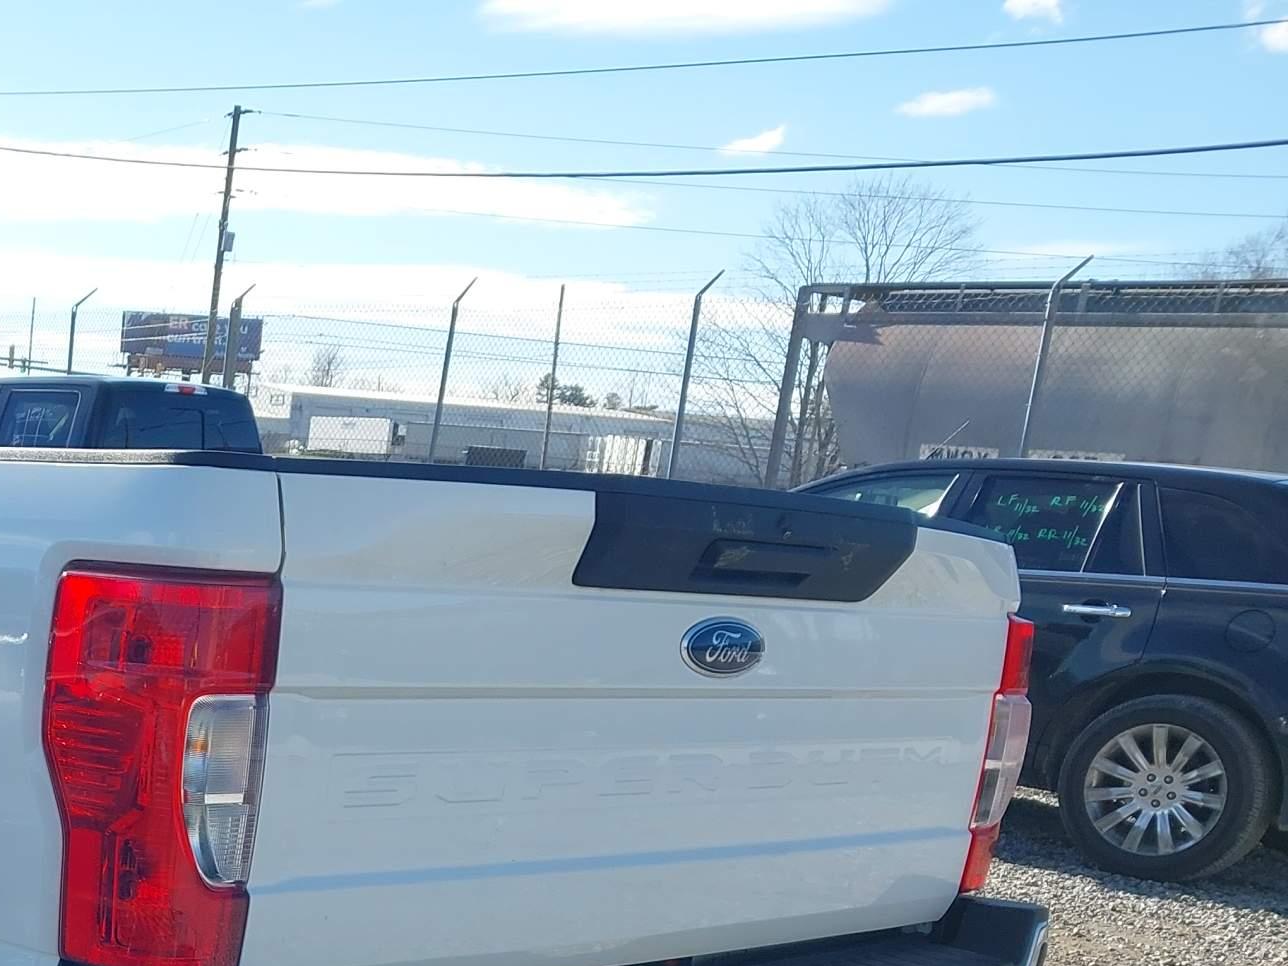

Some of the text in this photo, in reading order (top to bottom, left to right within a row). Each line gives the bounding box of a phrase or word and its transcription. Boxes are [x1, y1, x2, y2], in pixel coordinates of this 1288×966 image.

[997, 494, 1018, 506] LF
[1049, 495, 1076, 507] RF
[1036, 528, 1059, 540] RR
[706, 630, 752, 663] Ford
